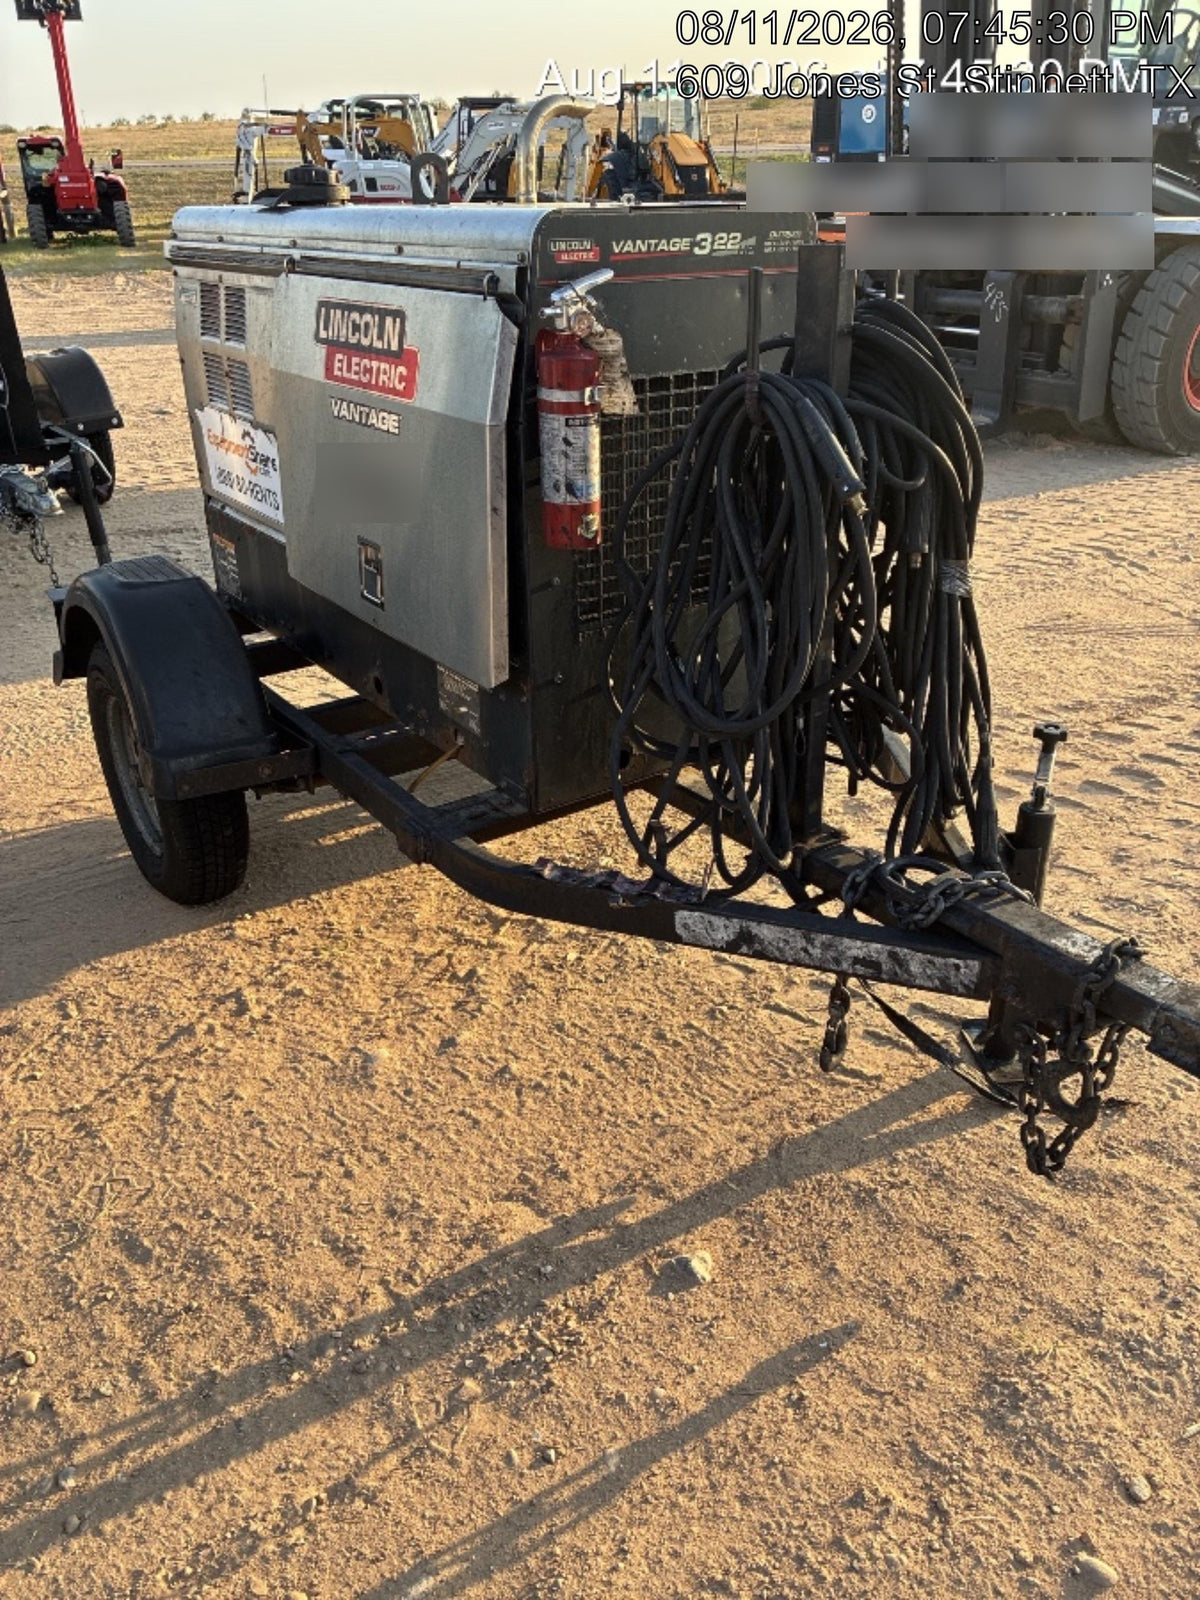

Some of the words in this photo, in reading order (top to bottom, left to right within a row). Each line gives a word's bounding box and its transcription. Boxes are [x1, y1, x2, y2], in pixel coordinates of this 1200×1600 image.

[612, 237, 692, 254] VANTAGE
[319, 306, 401, 352] LINCOLN
[333, 353, 408, 391] ELECTRIC
[330, 397, 402, 435] VANTAGE
